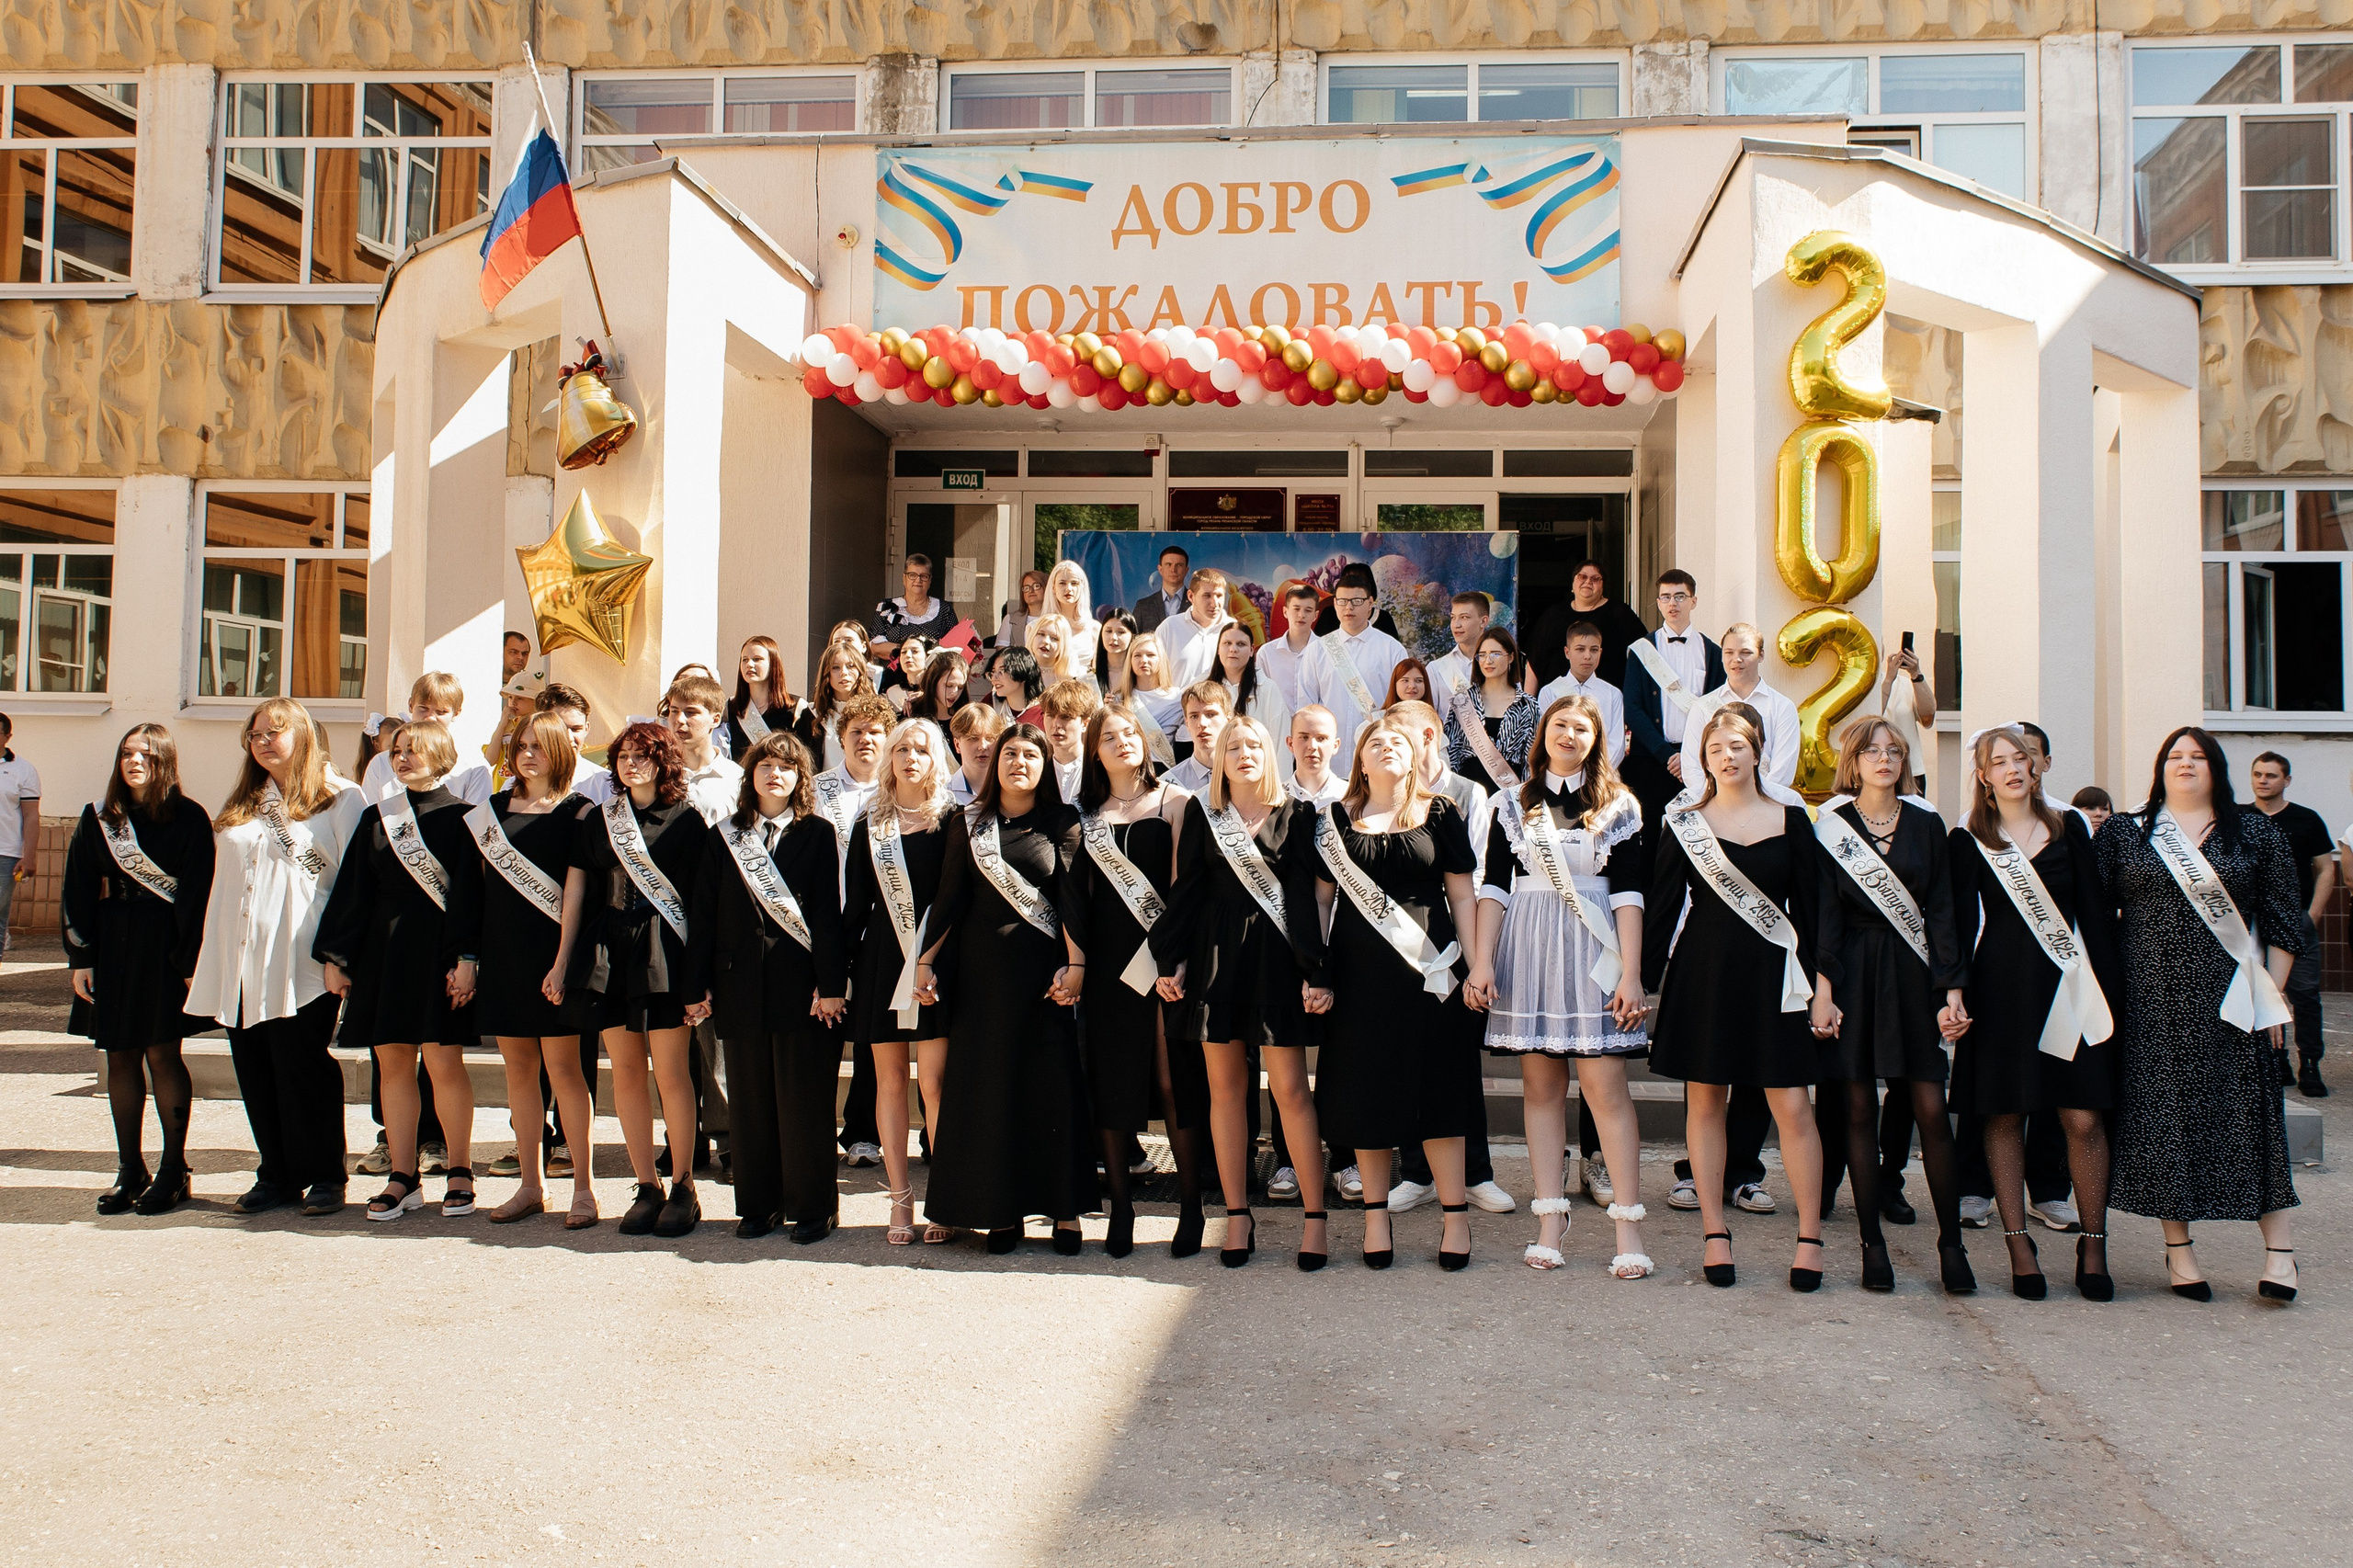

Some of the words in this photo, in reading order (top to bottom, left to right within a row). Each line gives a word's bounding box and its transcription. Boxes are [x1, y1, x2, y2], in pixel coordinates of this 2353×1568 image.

[1111, 180, 1370, 249] ДОБРО
[956, 280, 1529, 334] ПОЖАЛОВАТЬ!
[949, 473, 979, 487] ВХОД
[1519, 521, 1552, 531] ВХОД
[295, 848, 327, 875] 2025
[489, 843, 561, 914] Выпускник
[612, 821, 664, 900] Выпускник
[976, 843, 1037, 917] Выпускник
[1083, 819, 1138, 897] Выпускник
[1134, 891, 1164, 919] 2025
[1216, 822, 1278, 904] Выпускница
[1316, 822, 1368, 902] Выпускница
[1363, 892, 1395, 919] 2025
[1681, 828, 1749, 910] Выпускник
[1748, 899, 1781, 928] 2025
[2152, 812, 2205, 893] Выпускник
[2199, 890, 2234, 919] 2025
[896, 902, 915, 930] 2025
[1851, 858, 1924, 945] Выпускник
[1984, 846, 2051, 933] Выпускник
[2046, 929, 2080, 960] 2025
